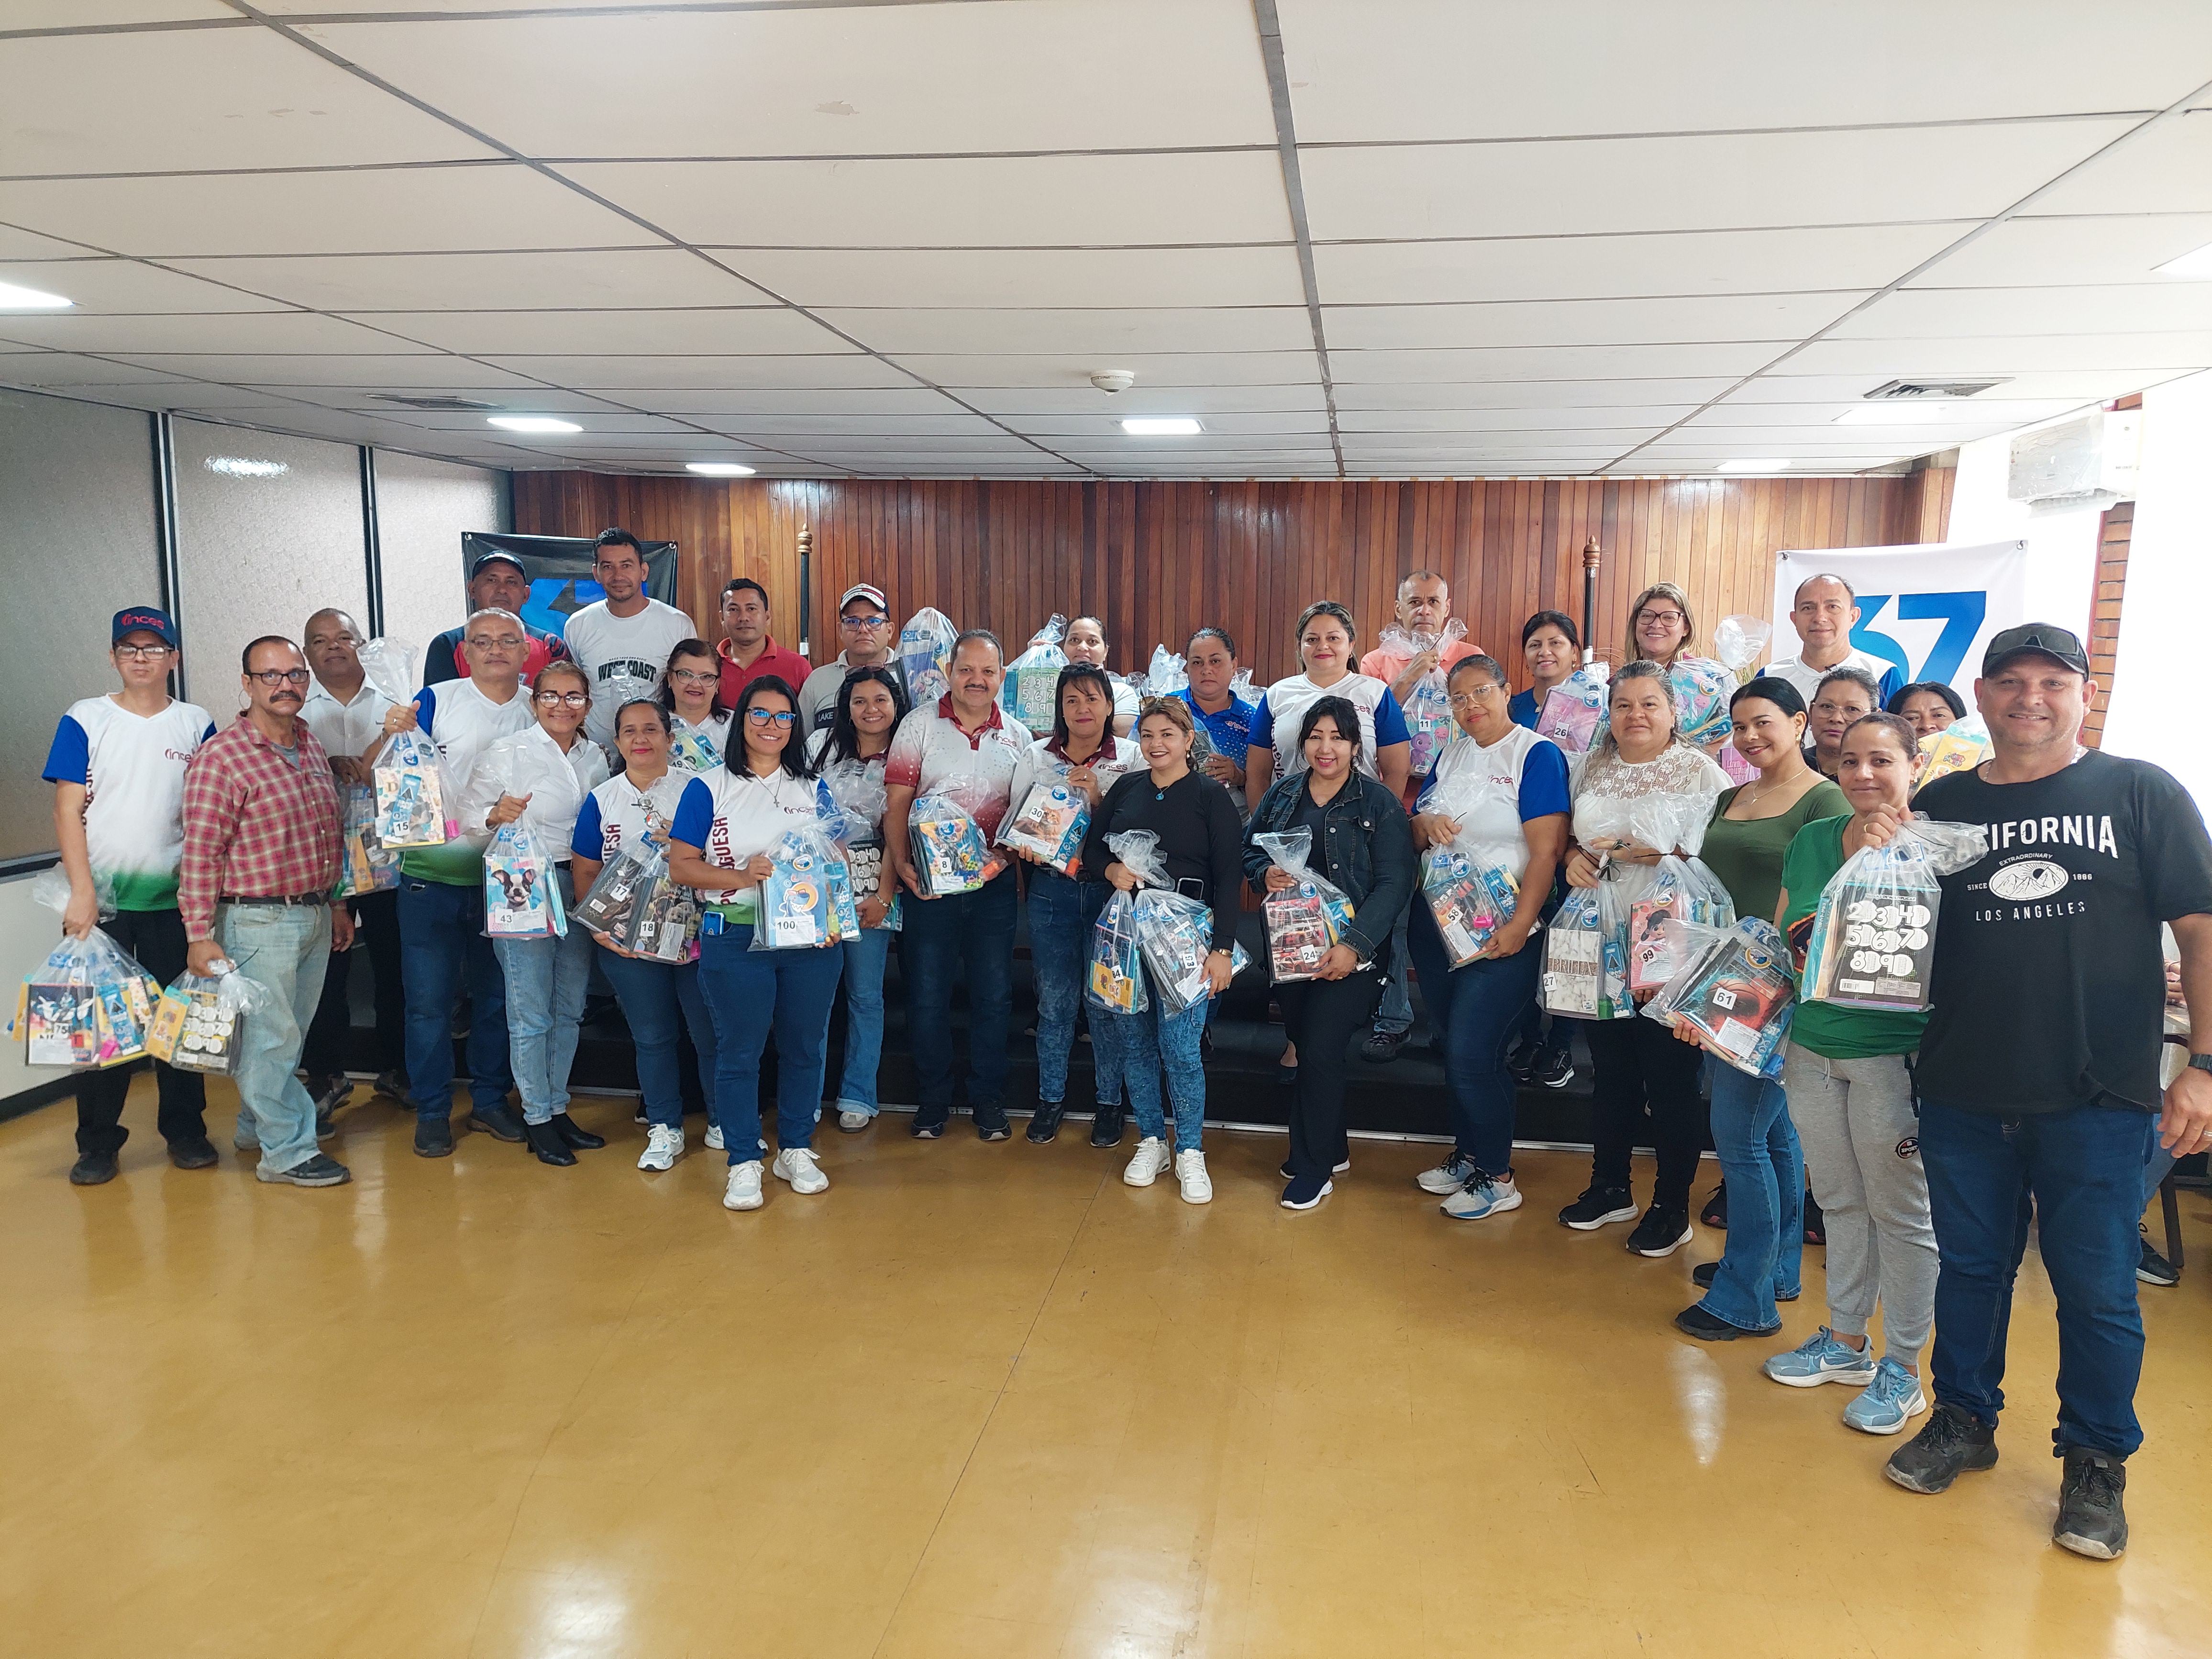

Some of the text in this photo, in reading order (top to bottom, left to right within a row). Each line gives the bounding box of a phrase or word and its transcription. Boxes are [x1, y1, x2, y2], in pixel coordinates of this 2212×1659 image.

[628, 660, 656, 683] COAST
[1022, 675, 1054, 688] 2 3 4
[1022, 688, 1055, 701] 5 6 7
[1024, 701, 1046, 714] 8 9
[1353, 705, 1370, 715] ces
[818, 712, 834, 722] LAKE
[1555, 728, 1567, 737] 26
[992, 733, 1018, 747] inces
[165, 749, 191, 763] ince
[1031, 807, 1042, 818] 30
[396, 822, 409, 832] 15
[1991, 815, 2119, 859] IFORNIA
[865, 848, 872, 861] 4
[1999, 852, 2053, 866] EXTRAORDINARY
[858, 863, 875, 878] 6 7
[616, 886, 627, 896] 17
[863, 879, 870, 891] 9
[1967, 883, 1987, 891] SINCE
[1448, 909, 1459, 921] 58
[1847, 903, 1862, 920] 2
[1872, 907, 1888, 926] 3
[1899, 904, 1913, 925] 4
[1976, 901, 2085, 921] LOS ANGELES
[500, 915, 512, 923] 43
[777, 920, 796, 930] 100
[642, 923, 653, 932] 18
[1846, 925, 1914, 951] 5 6 7
[1304, 951, 1316, 961] 24
[1643, 950, 1654, 962] 99
[1850, 951, 1894, 973] 8 9
[1112, 969, 1120, 979] 84
[1543, 977, 1554, 986] 27
[1717, 992, 1733, 1005] 61
